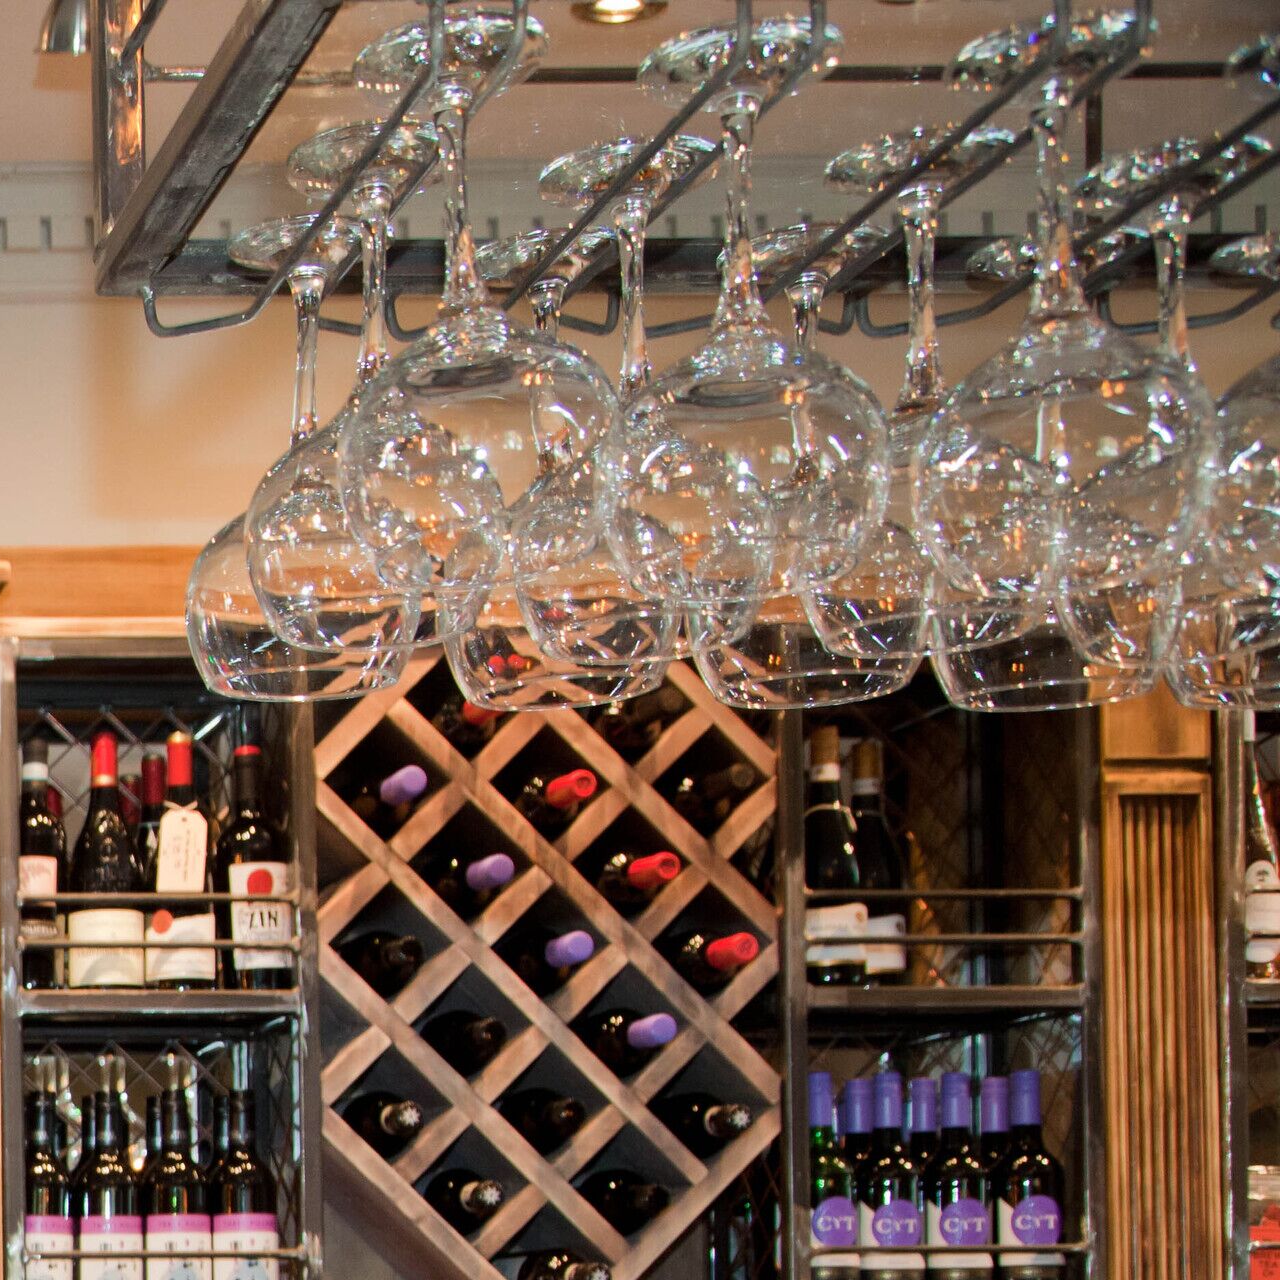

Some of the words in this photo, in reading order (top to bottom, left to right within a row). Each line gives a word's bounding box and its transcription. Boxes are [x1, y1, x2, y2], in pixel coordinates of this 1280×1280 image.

[816, 1216, 855, 1232] CYT
[875, 1218, 918, 1235] CYT
[944, 1217, 985, 1233] CYT
[1015, 1214, 1058, 1231] CYT
